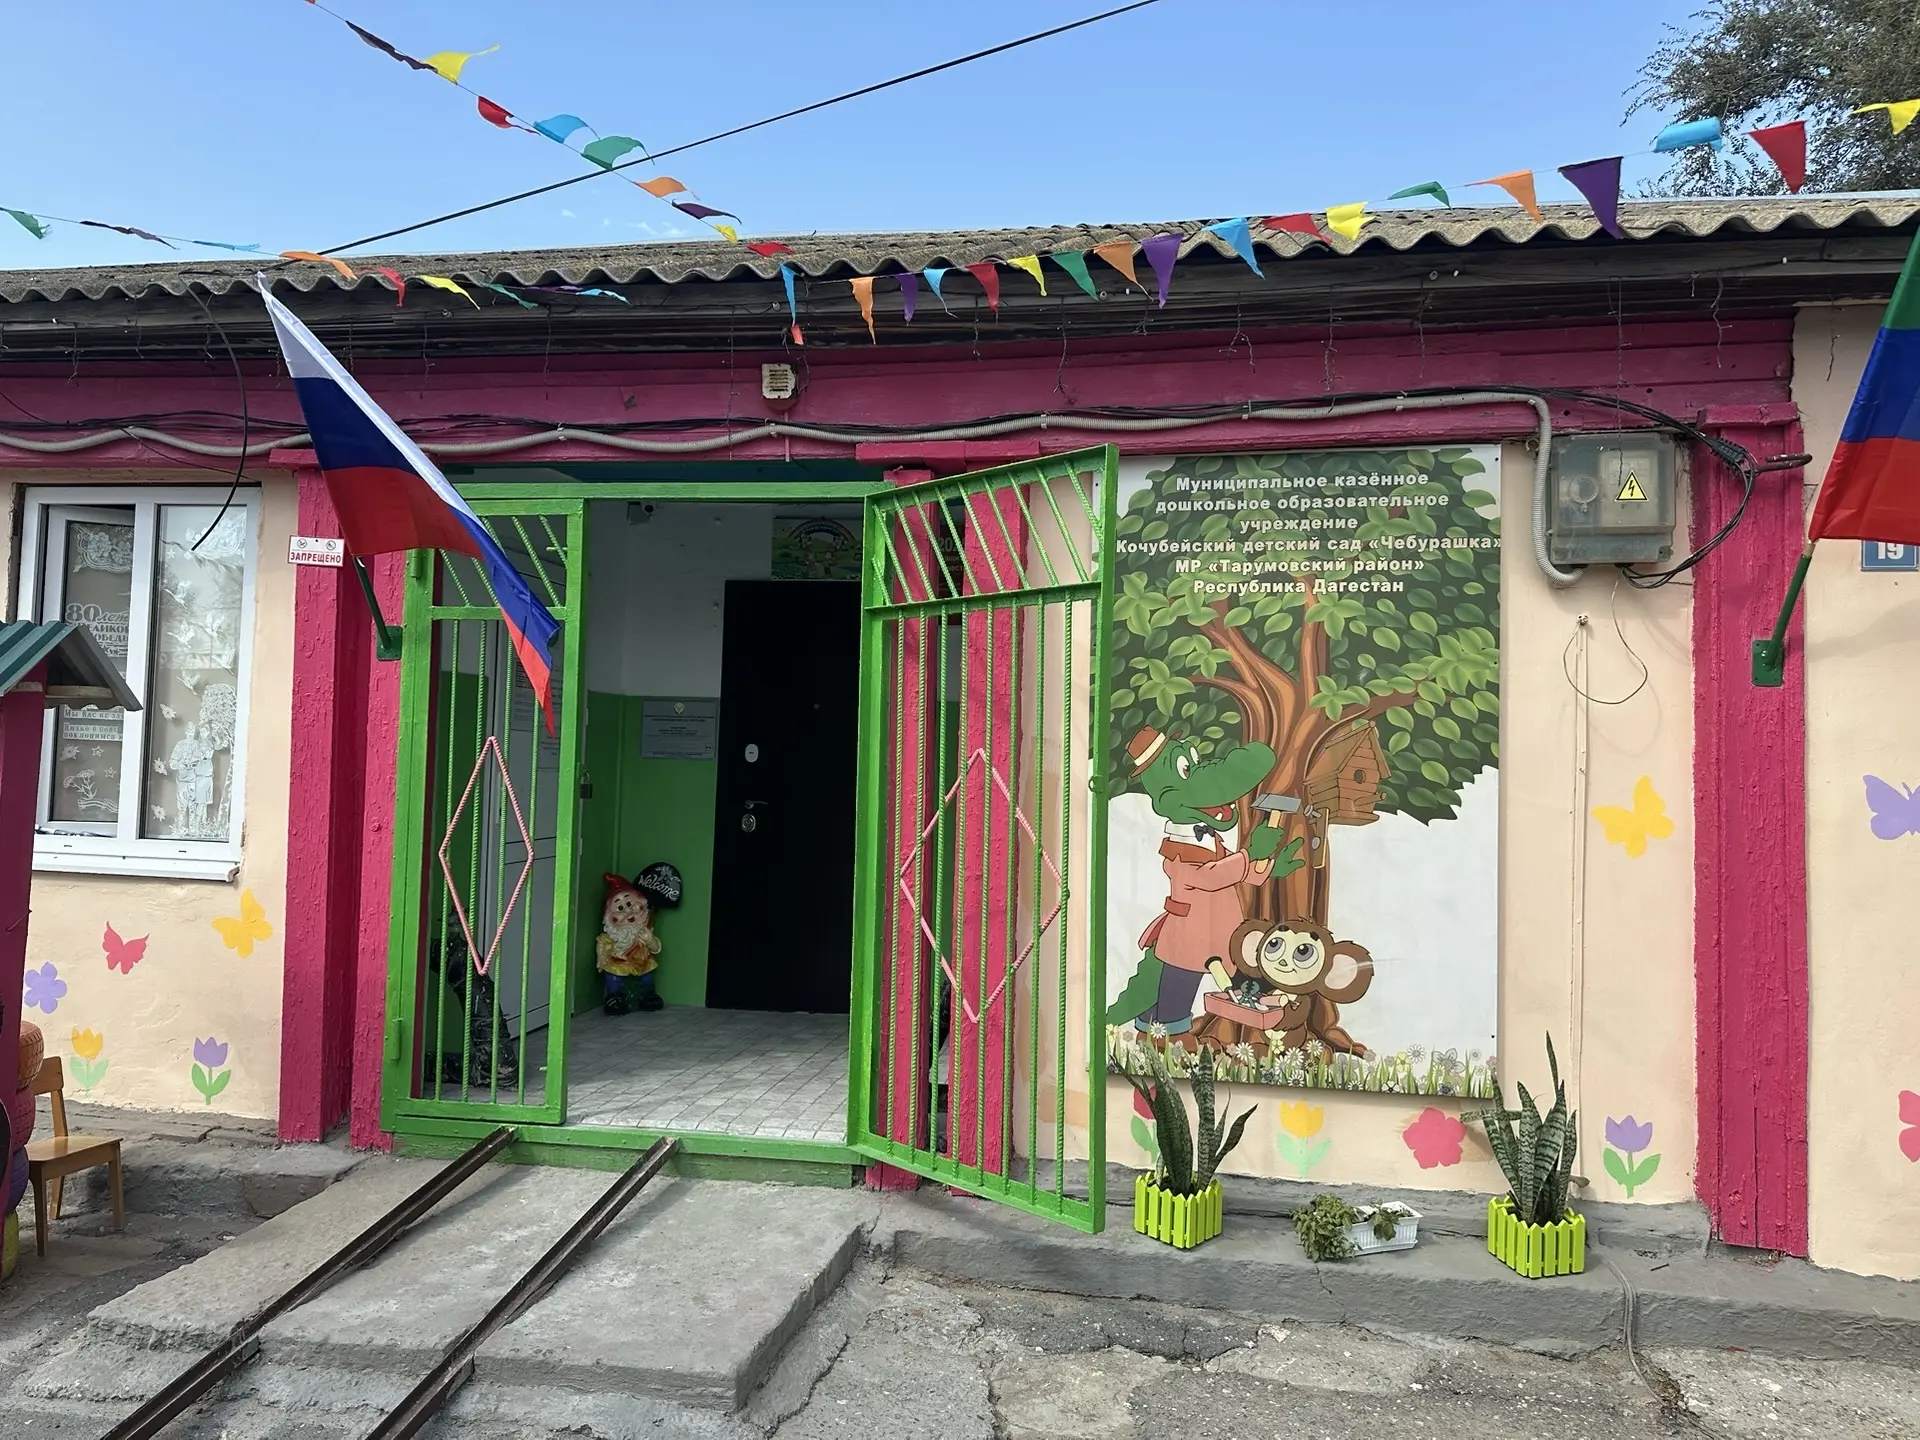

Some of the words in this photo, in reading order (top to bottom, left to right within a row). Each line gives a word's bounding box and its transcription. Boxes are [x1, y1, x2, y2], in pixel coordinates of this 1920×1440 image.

[1176, 475, 1328, 492] Муниципальное
[1334, 472, 1428, 487] казённое
[1155, 498, 1270, 514] дошкольное
[1277, 493, 1449, 510] образовательное
[1239, 518, 1358, 533] учреждение
[1116, 538, 1236, 554] Кочубейский
[1243, 537, 1320, 554] детский
[1327, 539, 1361, 552] сад
[1368, 536, 1502, 551] «Чебурашка»
[291, 552, 341, 563] ЗАПРЕЩЕНО
[1175, 560, 1202, 572] МР
[1208, 557, 1347, 573] «Тарумовский
[1354, 559, 1425, 573] район»
[1193, 580, 1306, 596] Республика
[1313, 580, 1404, 596] Дагестан
[65, 603, 101, 622] 80
[638, 875, 679, 901] Welcome
